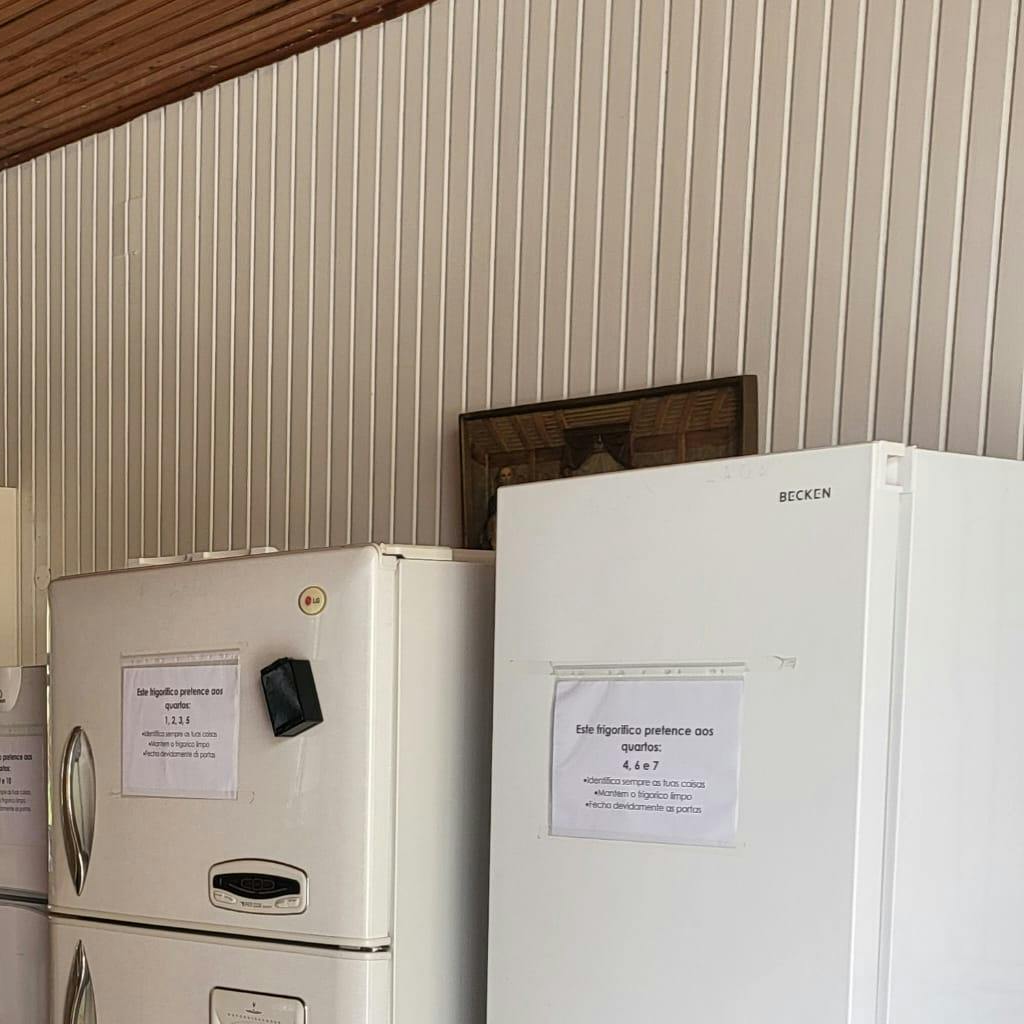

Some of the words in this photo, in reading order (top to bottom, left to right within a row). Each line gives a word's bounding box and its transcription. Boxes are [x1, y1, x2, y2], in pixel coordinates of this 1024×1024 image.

[779, 487, 831, 503] BECKEN
[137, 688, 148, 697] Este
[211, 688, 224, 696] aos
[165, 700, 191, 711] quartos:
[576, 724, 595, 735] Este
[644, 725, 692, 738] pretence
[695, 728, 714, 737] aos
[621, 742, 662, 755] quartos:
[622, 760, 632, 771] 4,
[634, 761, 641, 771] 6
[642, 762, 650, 771] e
[652, 761, 660, 771] 7
[622, 779, 651, 788] sempre
[663, 779, 679, 788] tuas
[630, 791, 637, 799] o
[613, 801, 665, 813] devidamente
[676, 804, 702, 815] portas
